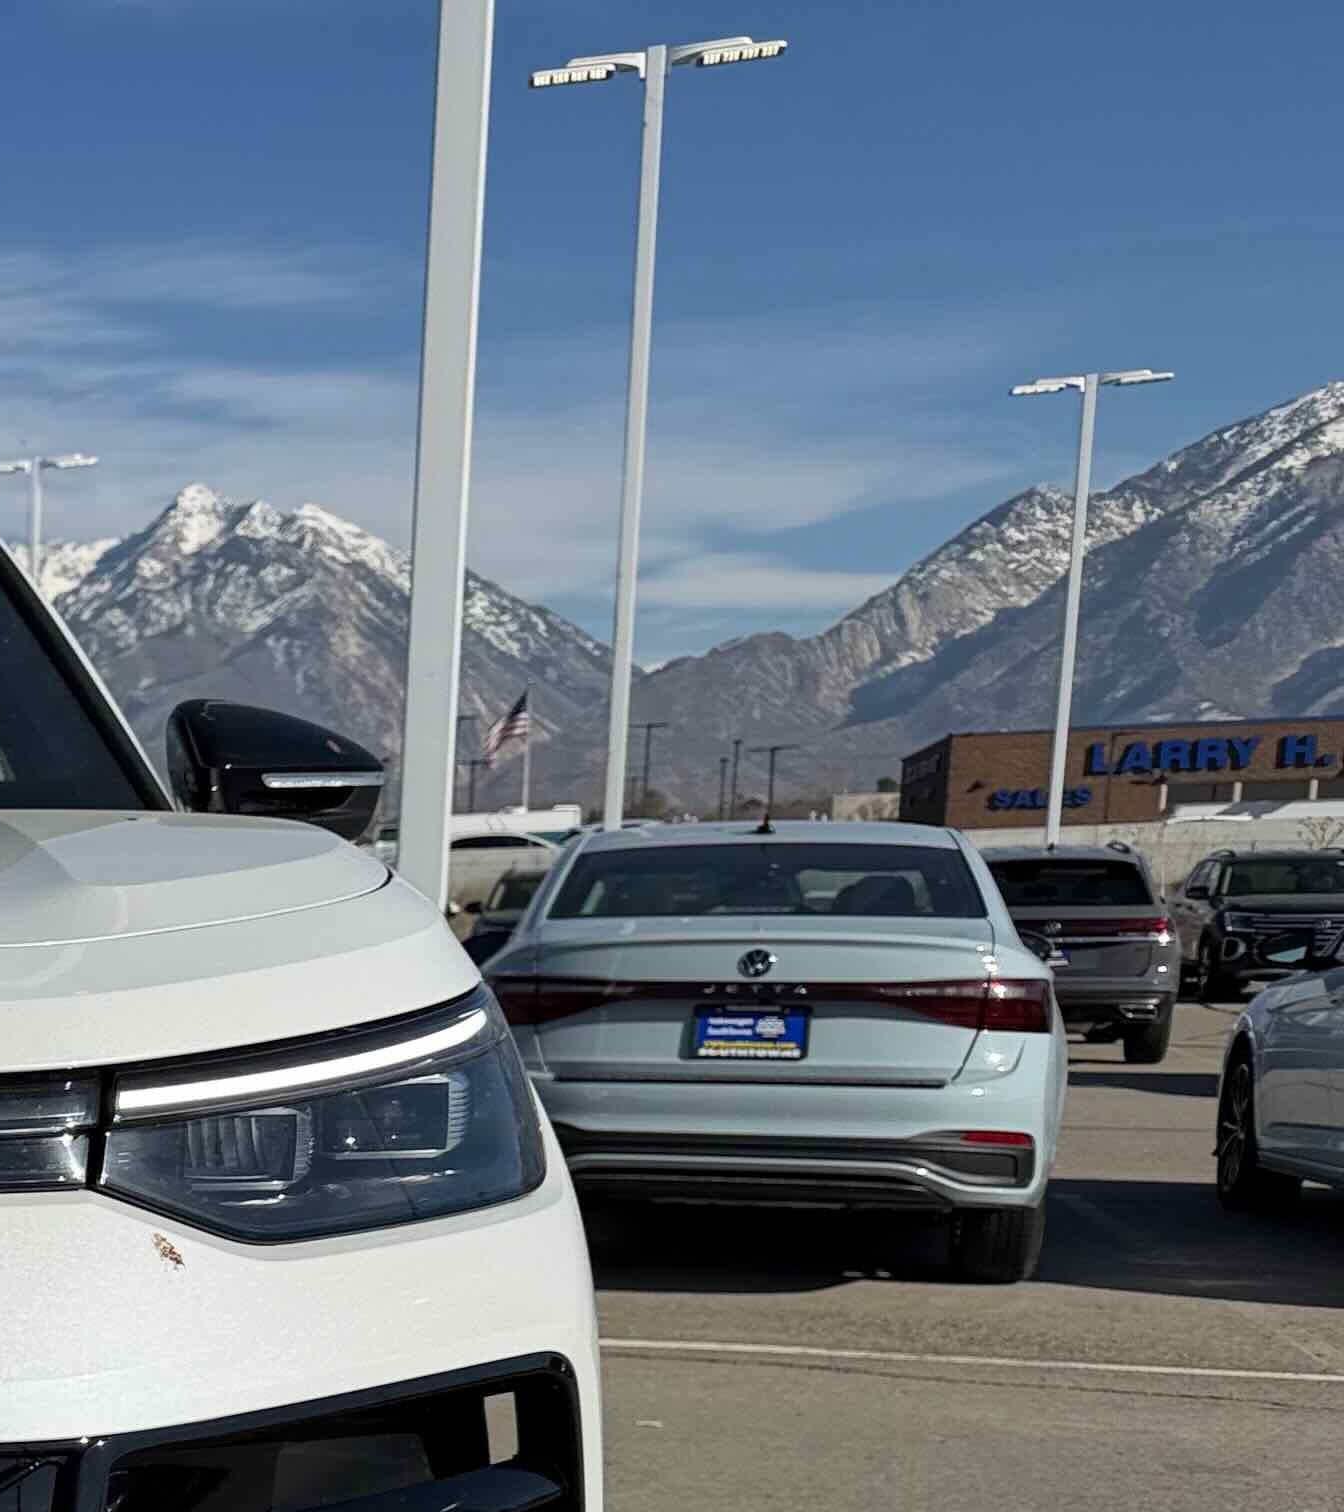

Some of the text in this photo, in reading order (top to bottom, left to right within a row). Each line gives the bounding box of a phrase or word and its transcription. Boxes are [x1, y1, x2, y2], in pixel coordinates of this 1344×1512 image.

[1087, 734, 1334, 775] LARRY H.
[703, 984, 807, 995] JETTA
